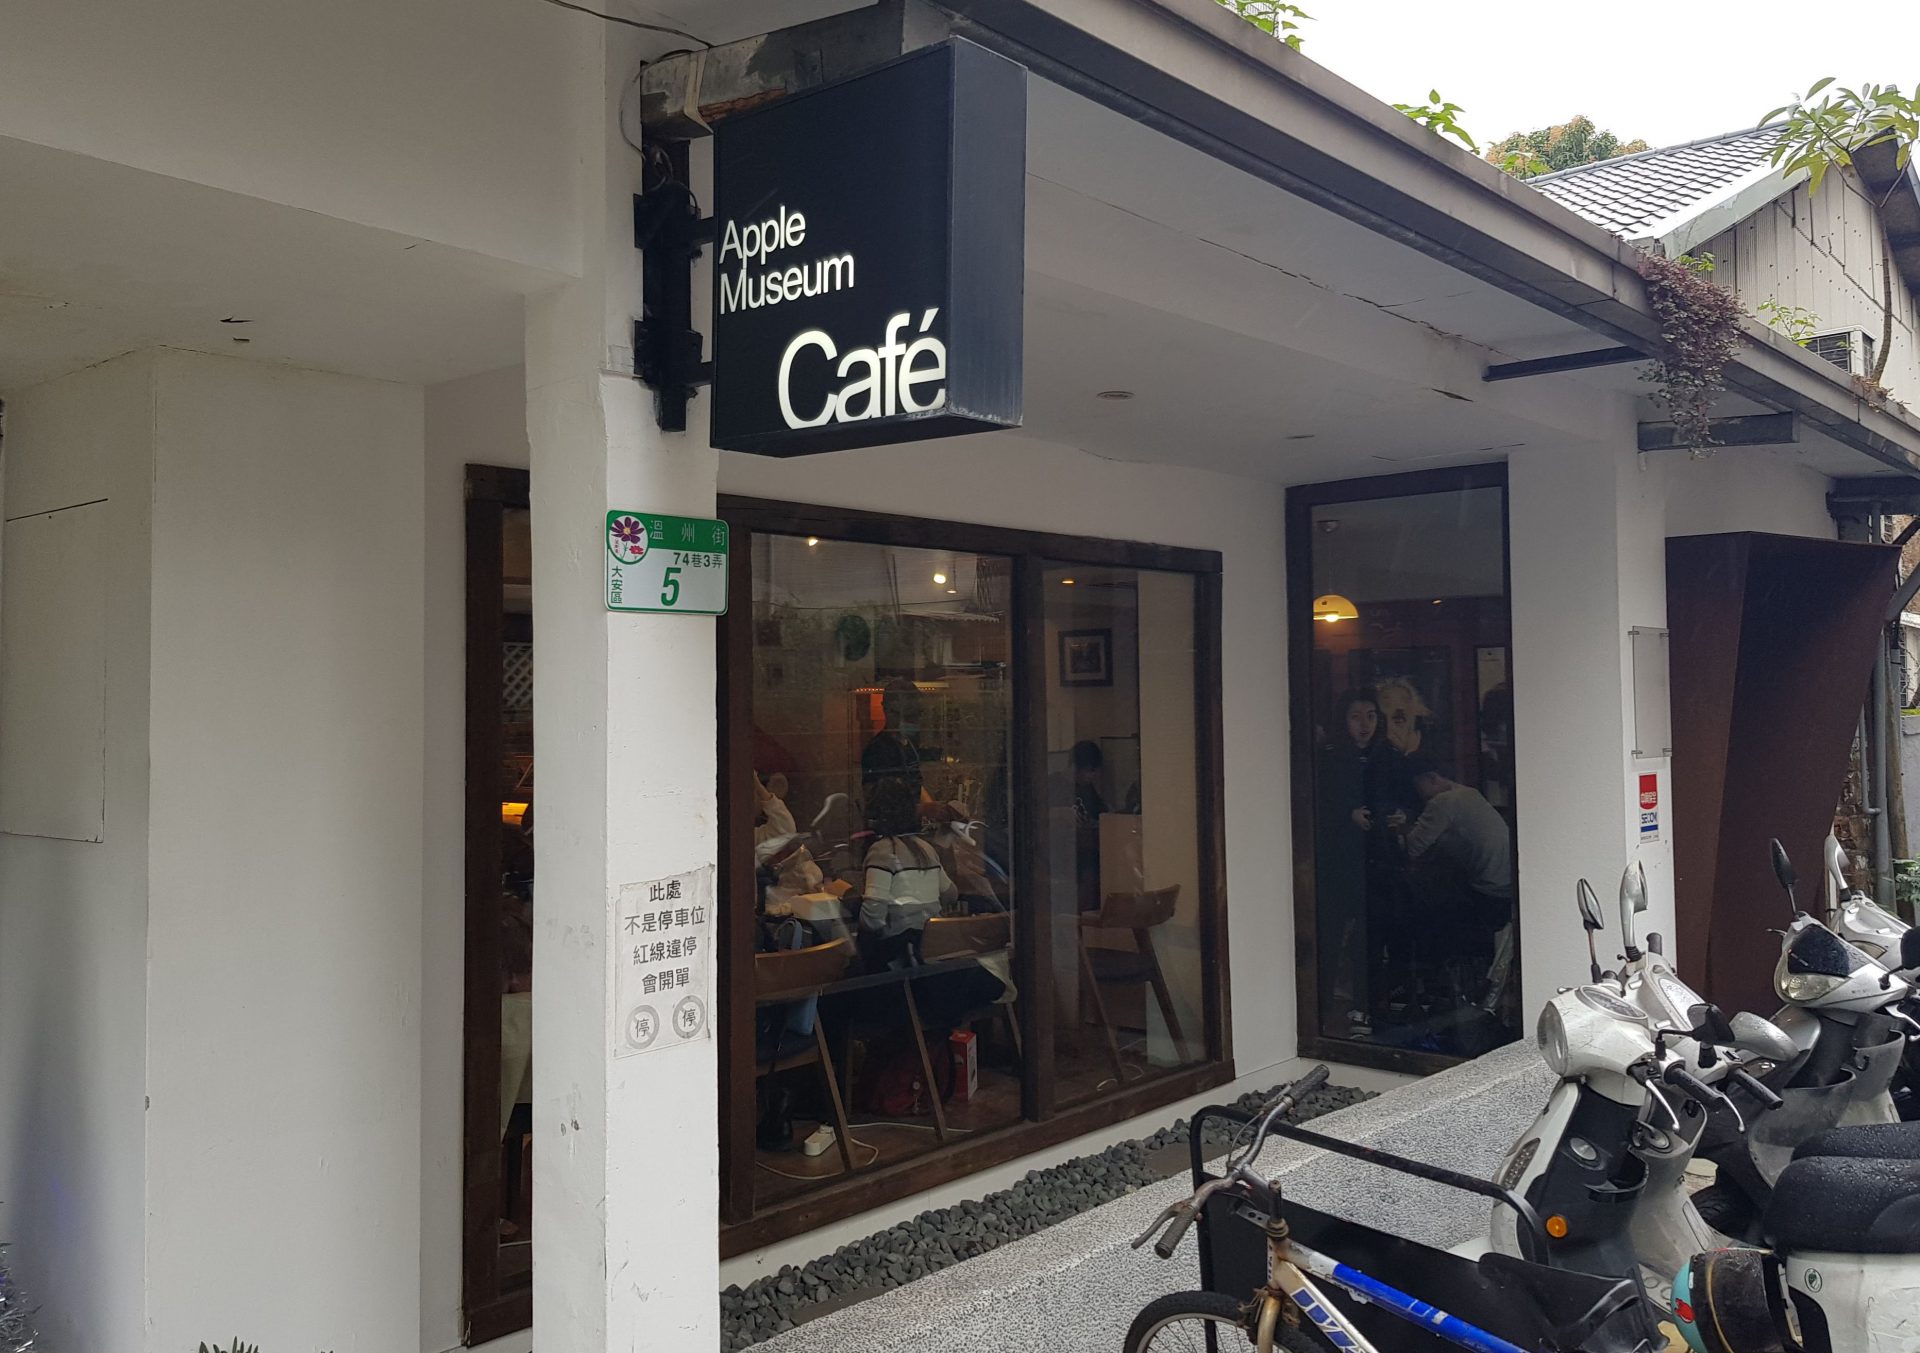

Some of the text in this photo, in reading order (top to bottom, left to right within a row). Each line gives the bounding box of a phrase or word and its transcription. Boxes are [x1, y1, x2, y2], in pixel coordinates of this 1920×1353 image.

[718, 204, 806, 269] Apple
[720, 253, 854, 315] Museum
[778, 307, 946, 430] Café
[673, 552, 723, 568] 74巷3弄
[611, 565, 623, 604] 大安區
[660, 567, 682, 607] 5
[649, 879, 682, 903] 此處
[624, 905, 705, 936] 不是停車位
[633, 936, 697, 966] 紅線違停
[641, 967, 690, 995] 會開單
[635, 1008, 696, 1038] 停 停
